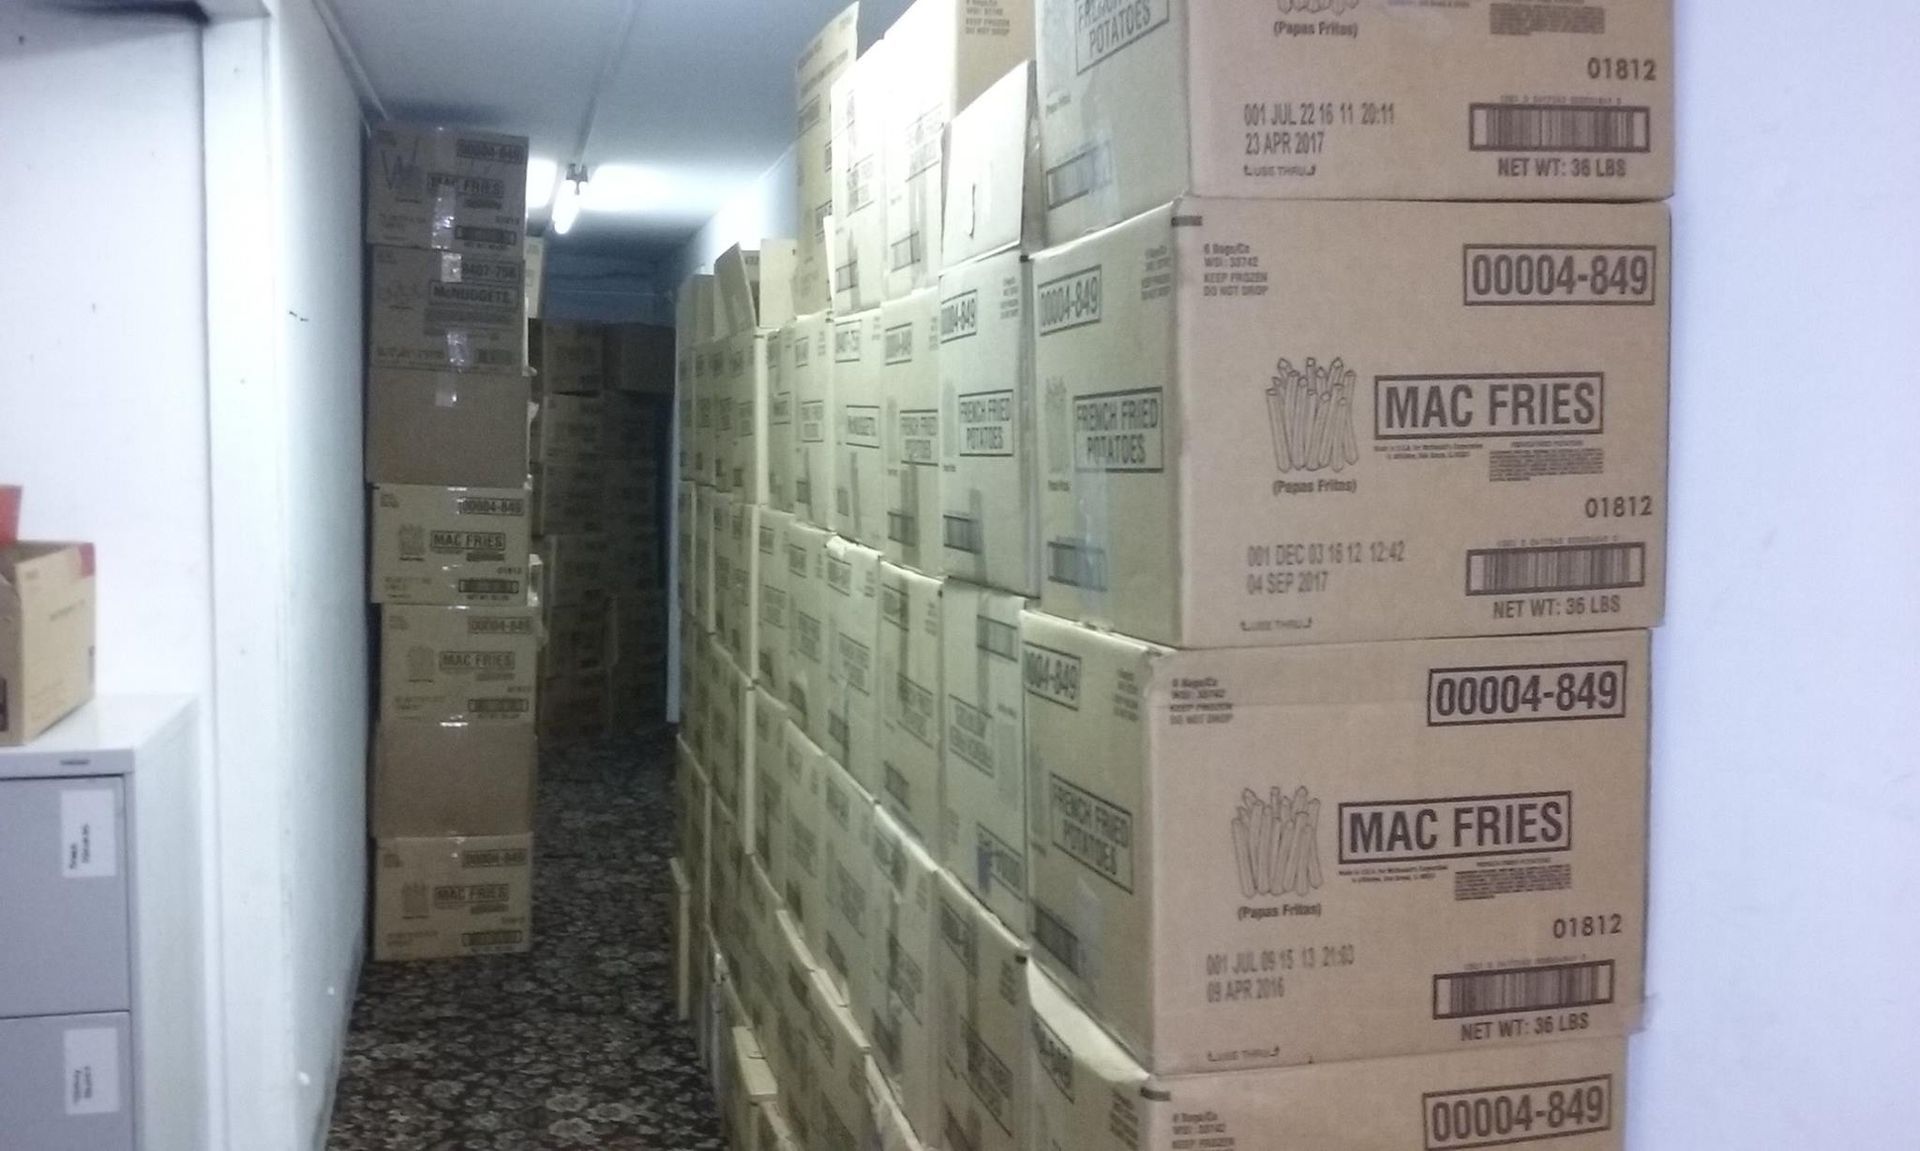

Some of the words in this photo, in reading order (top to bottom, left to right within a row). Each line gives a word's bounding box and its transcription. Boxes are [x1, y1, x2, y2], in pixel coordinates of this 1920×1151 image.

[1089, 1, 1151, 58] POTATOES
[1274, 21, 1316, 37] (Papas
[1317, 21, 1359, 38] Fritas)
[1587, 57, 1657, 81] 01812
[1244, 102, 1266, 126] 001
[1270, 103, 1297, 126] JUL
[1300, 102, 1315, 126] 22
[1319, 102, 1334, 126] 16
[1340, 102, 1354, 125] 11
[1360, 102, 1395, 125] 20:11
[1245, 132, 1260, 155] 23
[1263, 132, 1292, 155] APR
[1295, 131, 1325, 154] 2017
[1497, 158, 1531, 177] NET
[1535, 158, 1566, 177] WT:
[1570, 158, 1591, 177] 36
[1595, 158, 1627, 178] LBS
[1473, 253, 1649, 297] 00004-849
[1121, 398, 1159, 430] FRIED
[1385, 385, 1474, 429] MAC
[1489, 381, 1595, 426] FRIES
[1086, 433, 1146, 466] POTATOES
[1272, 480, 1316, 497] (Papas
[1317, 478, 1357, 495] Fritas)
[1585, 496, 1654, 519] 01812
[434, 533, 462, 546] MAC
[466, 535, 504, 549] FRIES
[1276, 544, 1305, 566] DEC
[1267, 572, 1294, 594] SEP
[1298, 571, 1328, 592] 2017
[1492, 600, 1528, 620] NET
[1530, 599, 1562, 617] WT:
[1566, 598, 1586, 616] 36
[1590, 596, 1621, 614] LBS
[1436, 671, 1618, 717] 00004-849
[1349, 807, 1438, 854] MAC
[1453, 799, 1564, 848] FRIES
[1238, 903, 1282, 922] (Papas
[1283, 900, 1323, 919] Fritas)
[1552, 914, 1623, 940] 01812
[1232, 951, 1258, 974] JUL
[1225, 979, 1252, 1001] APR
[1461, 1020, 1493, 1043] NET
[1498, 1018, 1531, 1039] WT:
[1534, 1016, 1555, 1037] 36
[1558, 1013, 1590, 1033] LBS
[1431, 1085, 1605, 1144] 00004-849
